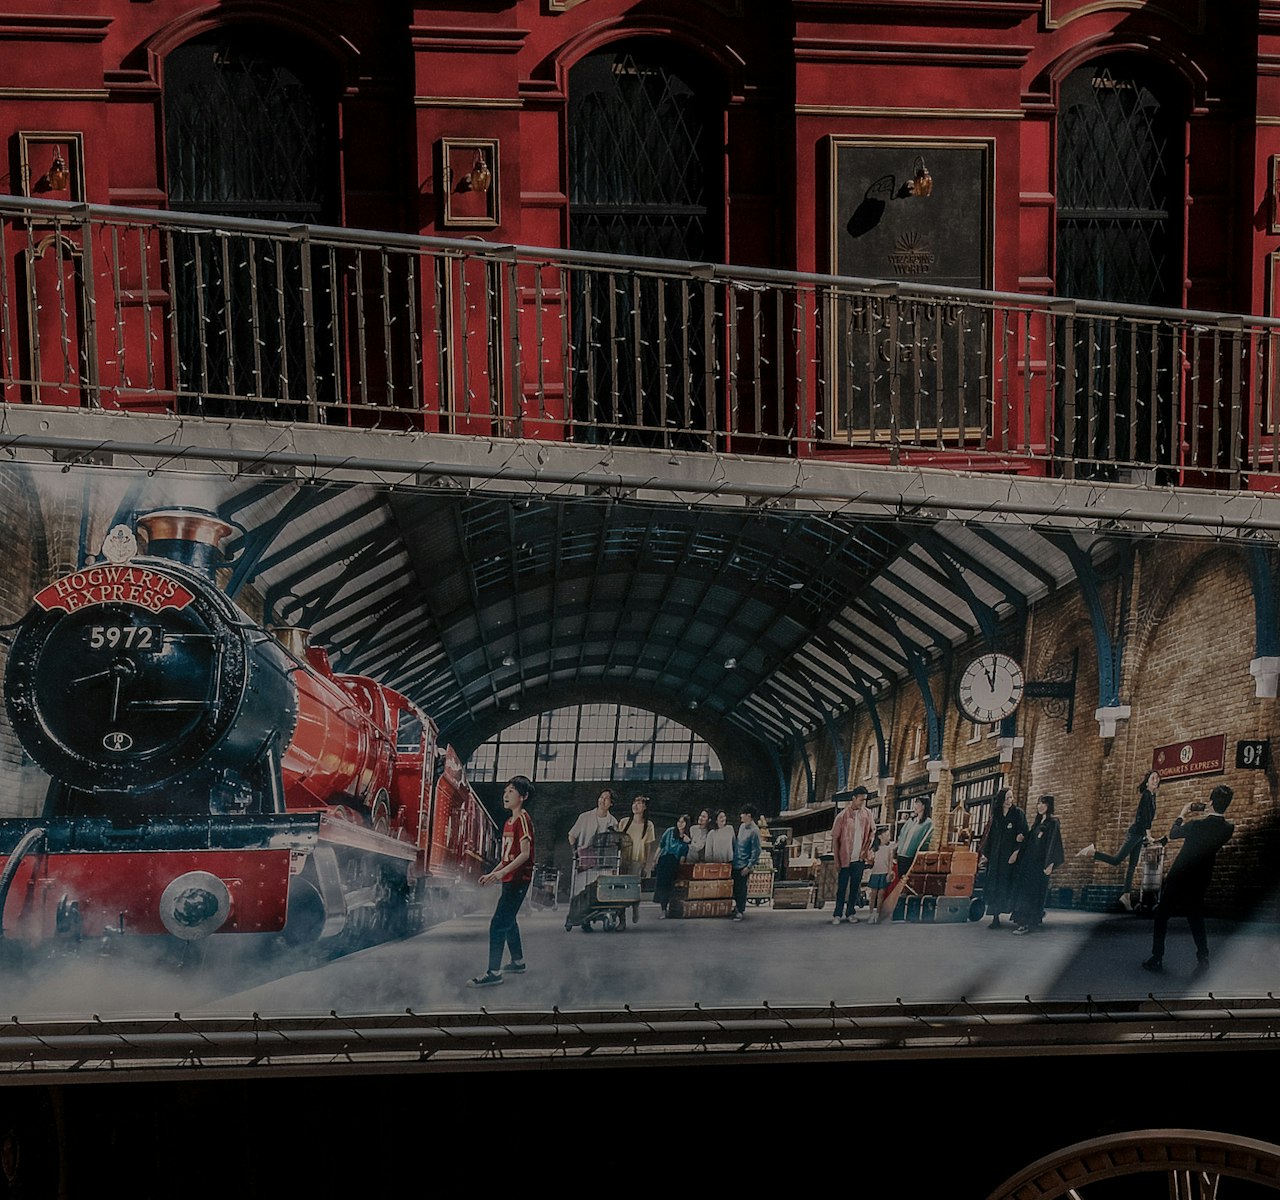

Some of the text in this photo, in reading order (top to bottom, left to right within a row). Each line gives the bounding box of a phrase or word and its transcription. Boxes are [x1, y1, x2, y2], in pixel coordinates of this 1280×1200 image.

[54, 567, 179, 598] HOGWARTS
[65, 584, 166, 612] EXPRESS
[90, 626, 153, 649] 5972
[1190, 760, 1220, 771] EXPRESS
